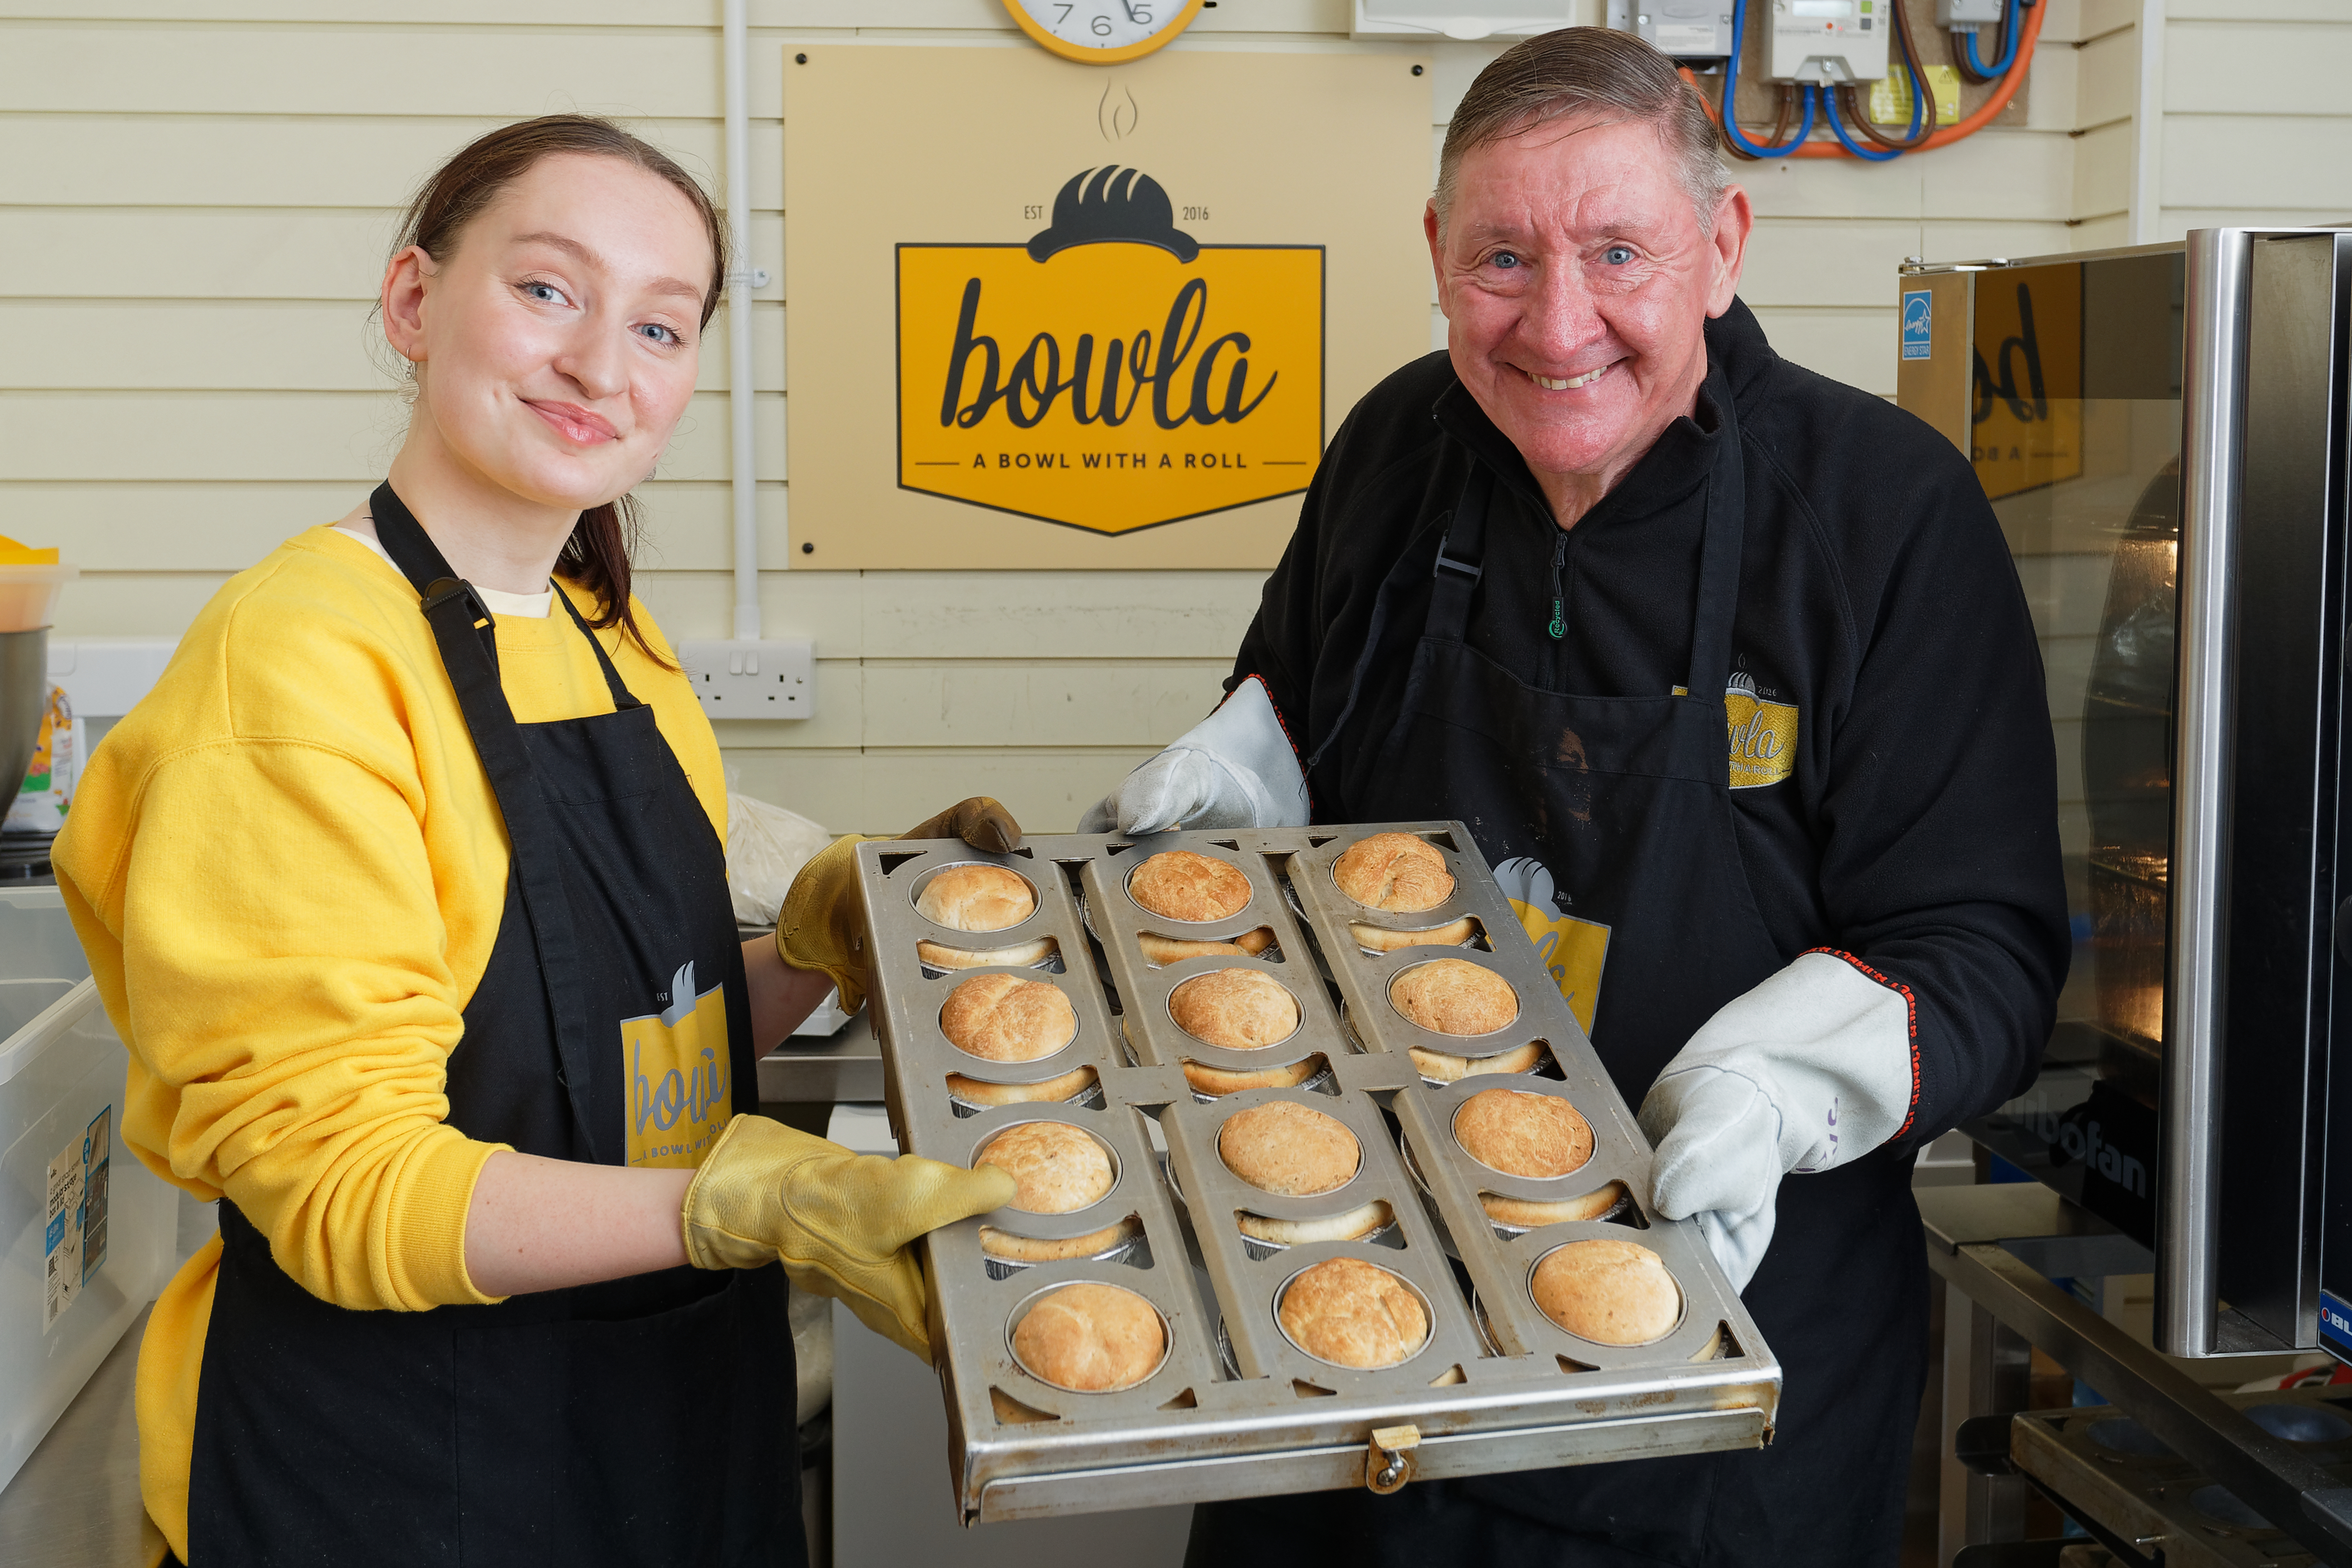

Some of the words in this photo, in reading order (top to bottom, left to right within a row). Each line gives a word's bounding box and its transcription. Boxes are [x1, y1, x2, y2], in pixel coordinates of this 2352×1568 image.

[1053, 3, 1073, 24] 7
[1132, 4, 1153, 24] 5
[1091, 15, 1112, 36] 6
[1024, 206, 1043, 220] EST
[1182, 206, 1209, 221] 2016
[941, 278, 1277, 429] bowla
[1904, 345, 1919, 356] ENERGY
[1919, 345, 1929, 355] STAR
[972, 453, 987, 468] A
[998, 453, 1070, 469] BOWL
[1082, 453, 1147, 469] WITH
[1158, 453, 1172, 468] A
[1184, 452, 1247, 469] ROLL
[1757, 686, 1777, 697] 2016
[1744, 764, 1752, 773] A
[1752, 765, 1781, 776] ROLL
[656, 992, 669, 1001] EST
[651, 1143, 692, 1159] BOWL
[695, 1133, 712, 1150] WIT
